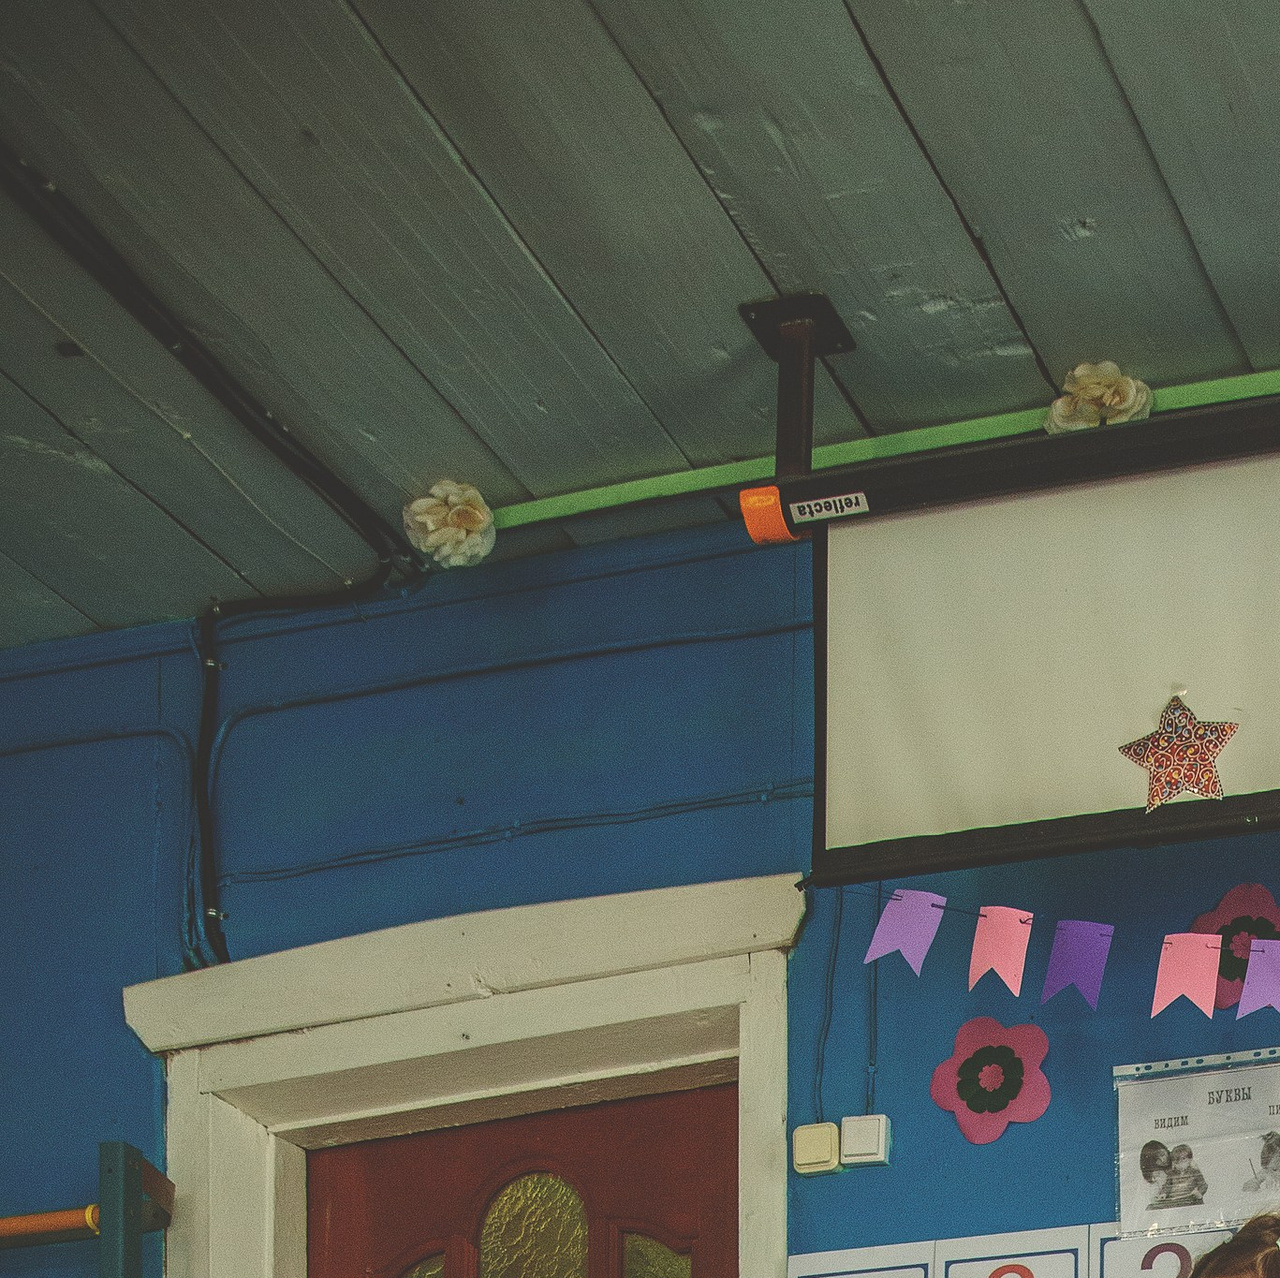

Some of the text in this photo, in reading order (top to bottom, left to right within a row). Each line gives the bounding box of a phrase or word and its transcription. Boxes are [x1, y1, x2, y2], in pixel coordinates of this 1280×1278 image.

[796, 496, 860, 518] reflecta
[1207, 1086, 1253, 1105] БУКВЫ
[1153, 1115, 1189, 1130] ВИДИМ
